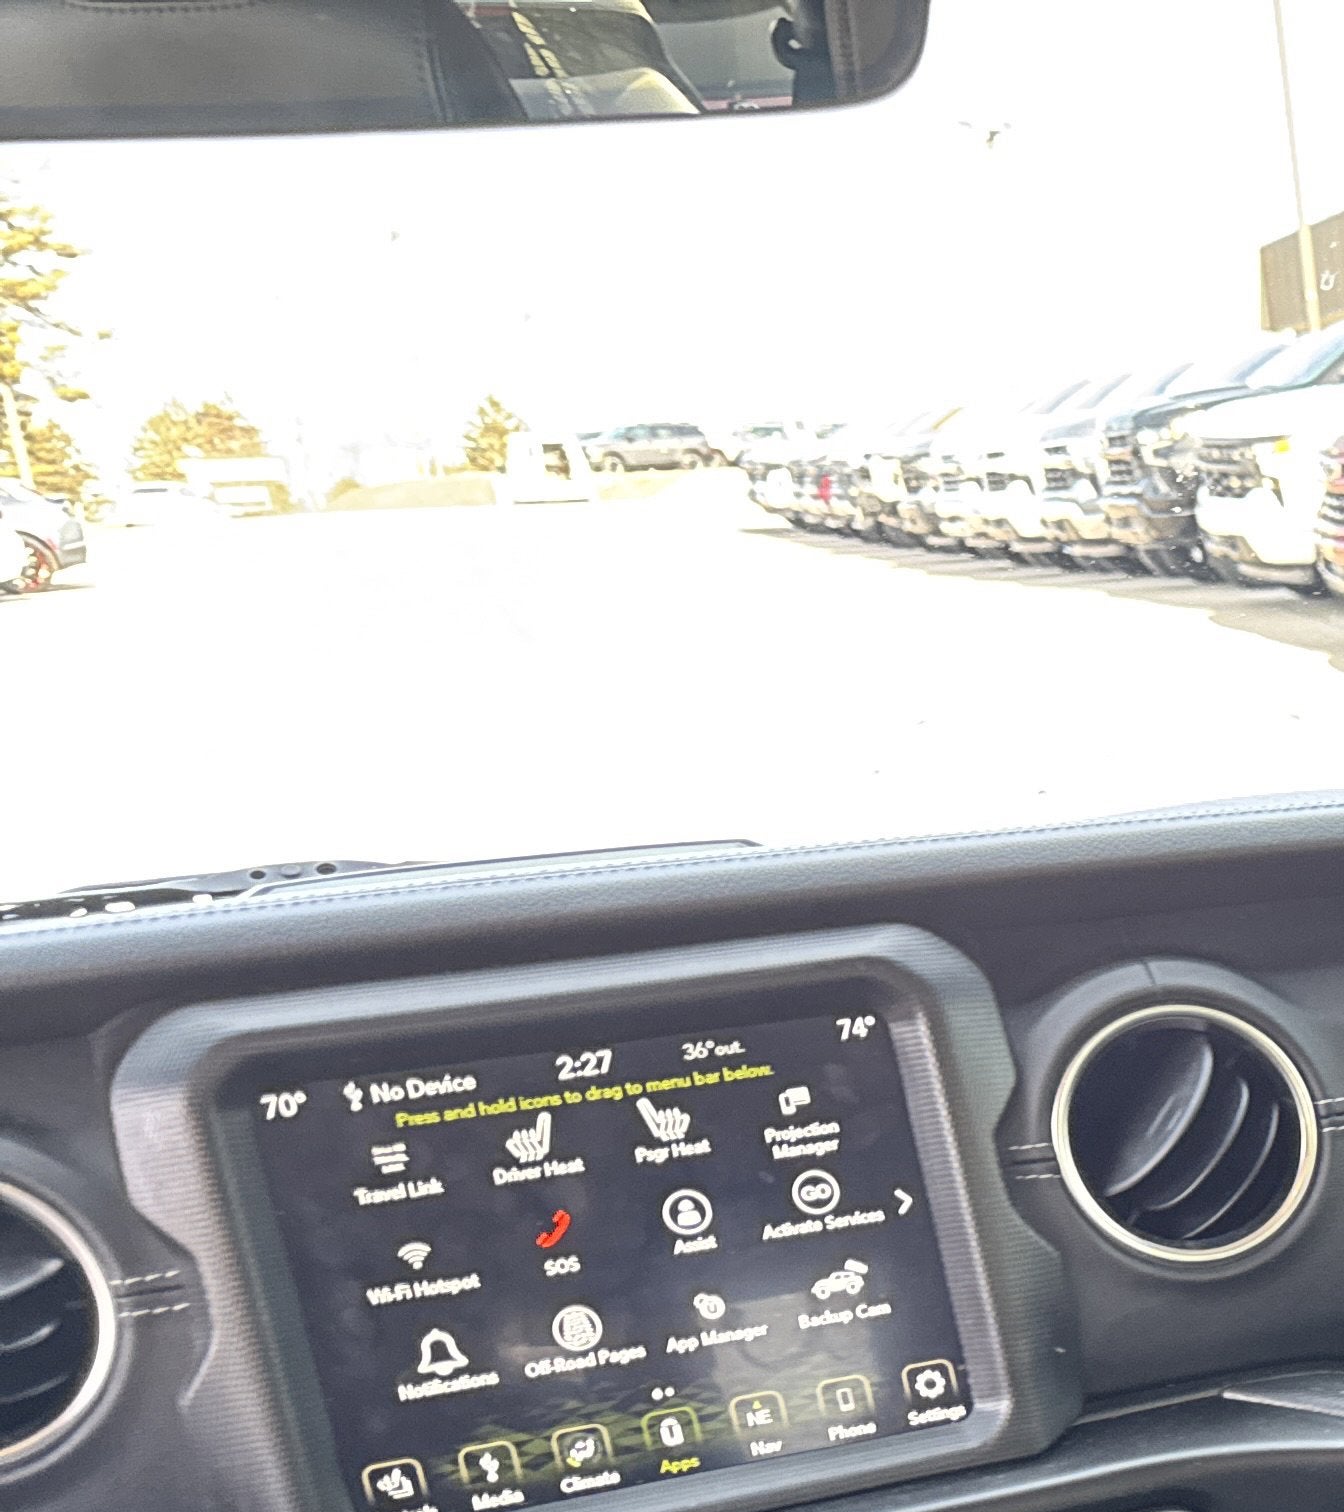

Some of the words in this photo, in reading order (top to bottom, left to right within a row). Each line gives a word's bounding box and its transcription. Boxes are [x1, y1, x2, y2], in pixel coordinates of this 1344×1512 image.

[836, 1015, 875, 1041] 74°
[555, 1048, 613, 1081] 2:27
[370, 1081, 405, 1104] No
[405, 1073, 477, 1100] Device
[395, 1110, 440, 1128] Press
[443, 1102, 477, 1122] and
[477, 1097, 517, 1117] hold
[517, 1093, 563, 1111] icons
[564, 1089, 583, 1104] to
[585, 1085, 624, 1101] drag
[624, 1081, 643, 1095] to
[645, 1075, 692, 1093] menu
[692, 1070, 721, 1086] bar
[722, 1064, 775, 1082] below.
[259, 1090, 307, 1121] 70°
[763, 1121, 841, 1144] Projection
[633, 1145, 670, 1163] Psgr
[670, 1138, 713, 1158] Heat
[771, 1138, 840, 1160] Manager
[492, 1164, 543, 1186] Driver
[543, 1157, 586, 1178] Heat
[353, 1181, 407, 1206] Travel
[407, 1175, 446, 1198] Link
[799, 1182, 833, 1202] GO
[762, 1218, 823, 1241] Activate
[824, 1209, 886, 1231] Services
[673, 1234, 719, 1256] Assist
[543, 1254, 582, 1277] SOS
[365, 1281, 414, 1306] Wi-Fi
[414, 1272, 482, 1299] Hotspot
[797, 1309, 854, 1330] Backup
[855, 1301, 892, 1319] Cam
[665, 1336, 700, 1354] App
[700, 1322, 769, 1348] Manager
[524, 1350, 597, 1379] Off-Road
[597, 1344, 648, 1366] Pages
[397, 1370, 500, 1402] Notifications
[745, 1408, 774, 1427] NE
[907, 1404, 968, 1427] Settings
[827, 1421, 877, 1442] Phone
[749, 1438, 783, 1457] Nav
[658, 1456, 702, 1474] Apps
[559, 1470, 622, 1494] Climate
[471, 1487, 525, 1511] Media
